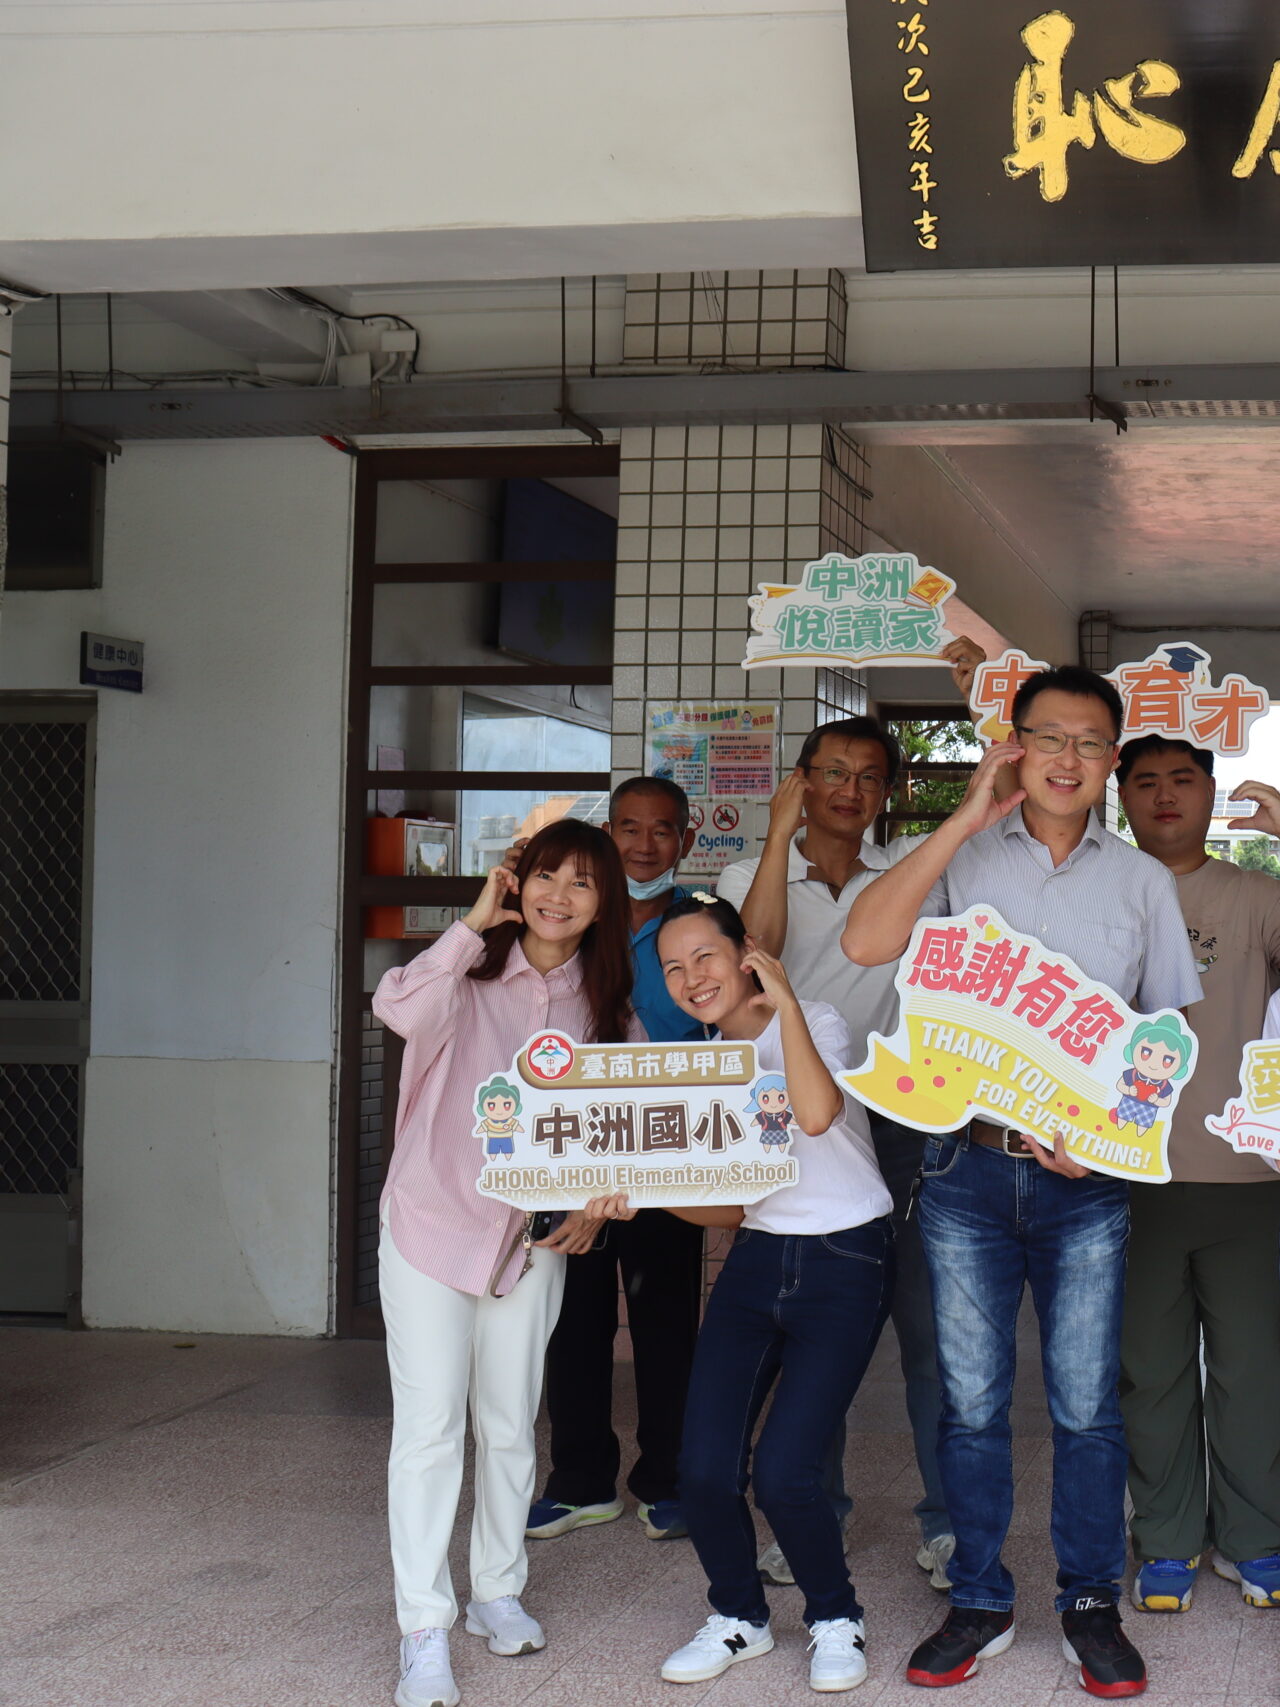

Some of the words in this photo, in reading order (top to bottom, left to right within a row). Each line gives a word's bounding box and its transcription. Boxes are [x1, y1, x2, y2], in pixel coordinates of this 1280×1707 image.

[891, 0, 939, 250] 次己亥年吉
[808, 556, 914, 603] 中洲
[778, 604, 941, 652] 悅讀家
[93, 642, 139, 666] 健康中心
[977, 656, 1262, 749] 中育才
[698, 834, 744, 852] Cycling
[906, 926, 1125, 1066] 感謝有您
[580, 1050, 745, 1080] 臺南市學甲區
[921, 1021, 1008, 1073] THANK
[1008, 1056, 1060, 1104] YOU
[533, 1101, 745, 1157] 中洲國小
[974, 1079, 1018, 1112] FOR
[1018, 1100, 1152, 1170] EVERYTHING!
[1237, 1132, 1274, 1151] Love
[481, 1168, 550, 1191] JHONG
[554, 1166, 609, 1190] JHOU
[615, 1163, 726, 1189] Elementary
[730, 1160, 796, 1184] School
